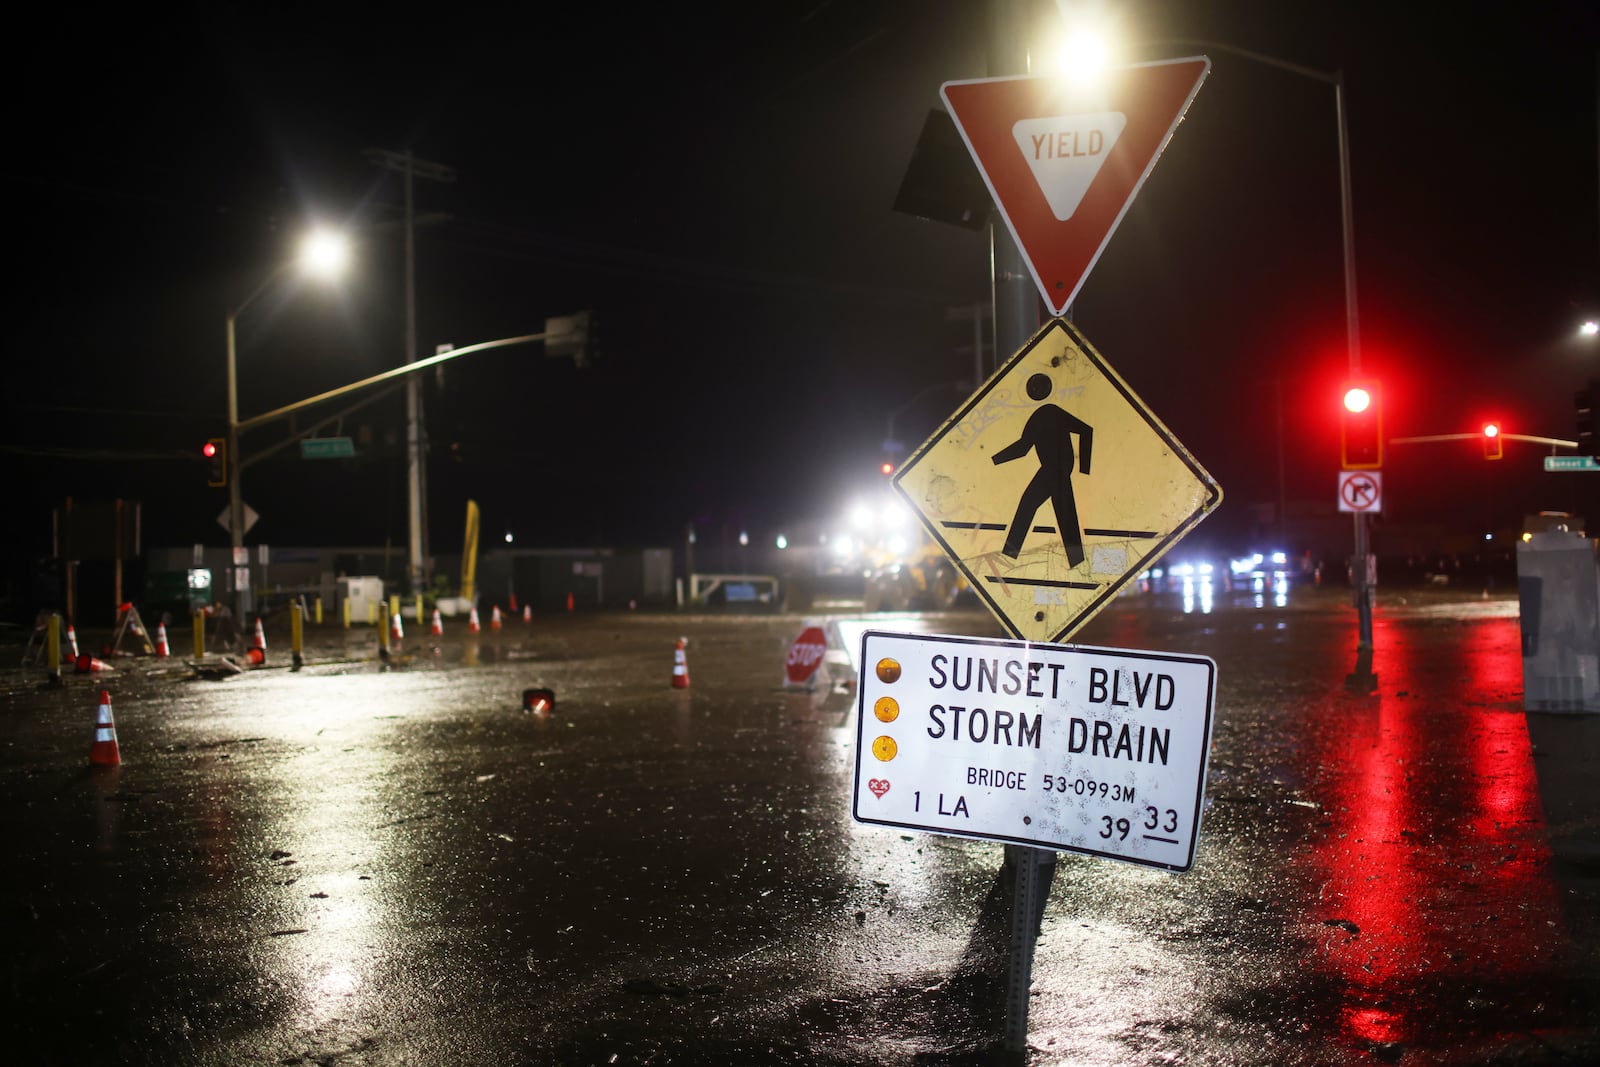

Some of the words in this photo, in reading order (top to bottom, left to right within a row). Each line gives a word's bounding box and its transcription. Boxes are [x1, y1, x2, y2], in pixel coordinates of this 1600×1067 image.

[1031, 130, 1104, 160] YIELD
[788, 644, 825, 666] STOP
[929, 654, 1065, 699] SUNSET
[1088, 667, 1176, 711] BLVD
[926, 704, 1043, 749] STORM
[1068, 717, 1171, 766] DRAIN
[967, 767, 1027, 791] BRIDGE
[1042, 774, 1136, 804] 53-0993M
[913, 790, 921, 813] 1
[938, 793, 970, 818] LA
[1099, 815, 1131, 841] 39
[1143, 806, 1179, 833] 33
